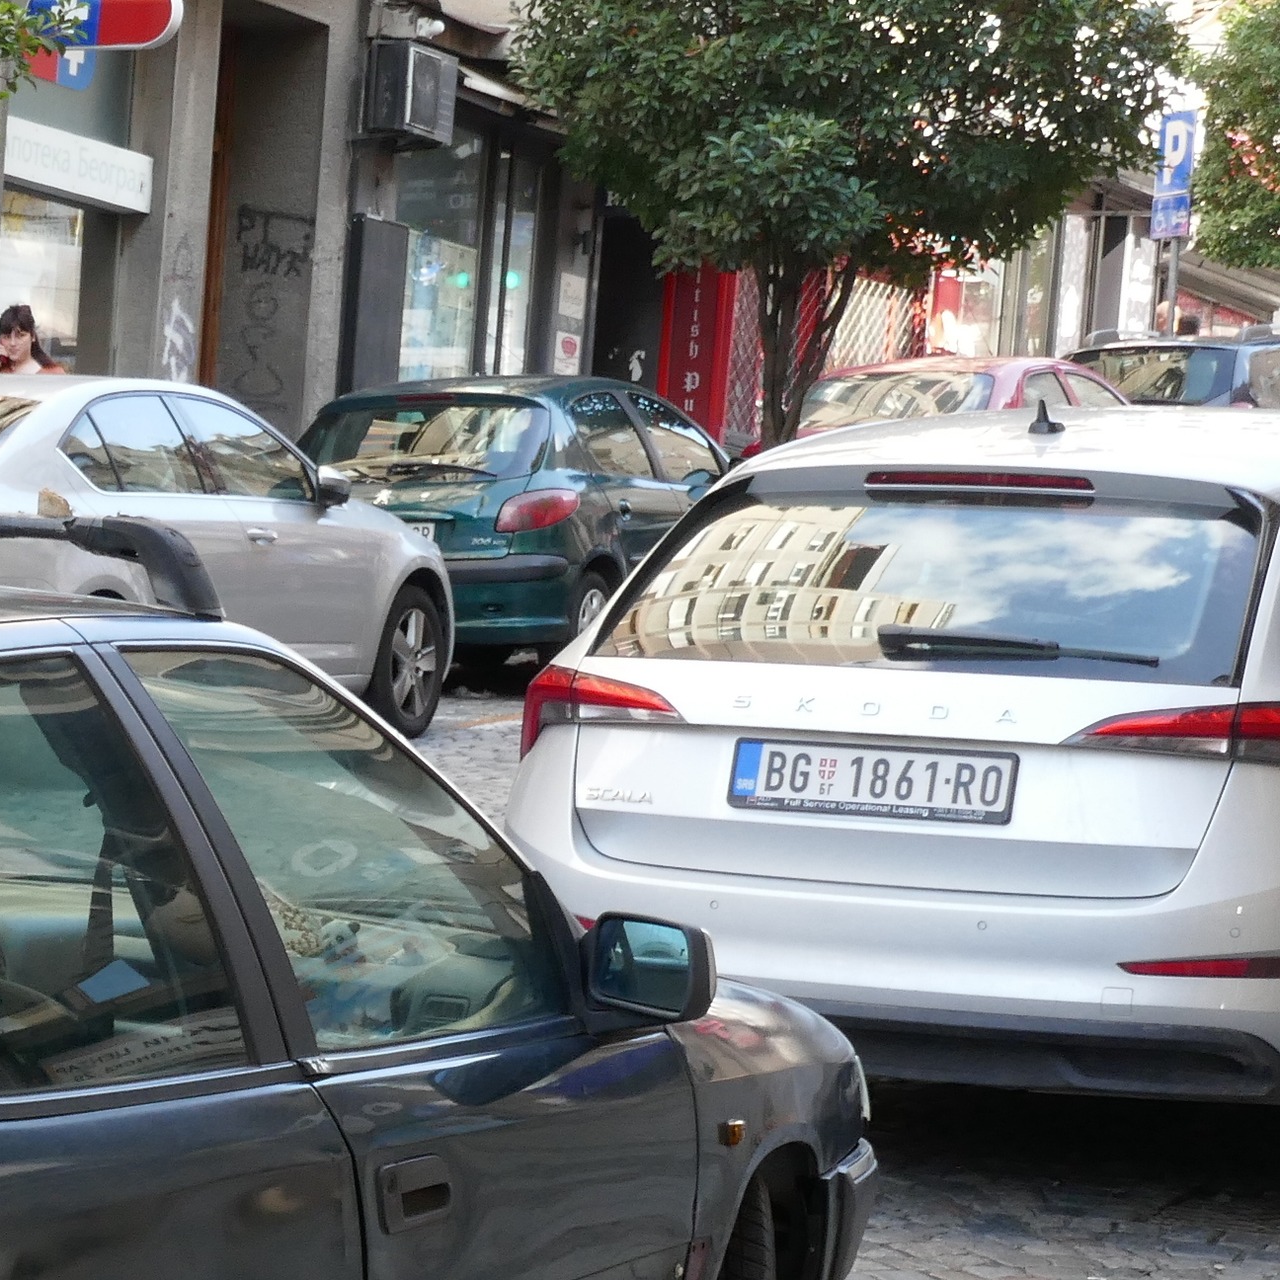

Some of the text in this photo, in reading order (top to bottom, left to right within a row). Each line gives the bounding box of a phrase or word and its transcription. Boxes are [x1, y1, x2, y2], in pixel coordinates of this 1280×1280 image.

[1162, 119, 1188, 186] P
[764, 750, 812, 794] BG
[585, 787, 653, 806] SCALA
[784, 797, 800, 807] Full
[803, 799, 836, 809] Service
[838, 800, 890, 813] Operational
[892, 804, 930, 817] Leasing
